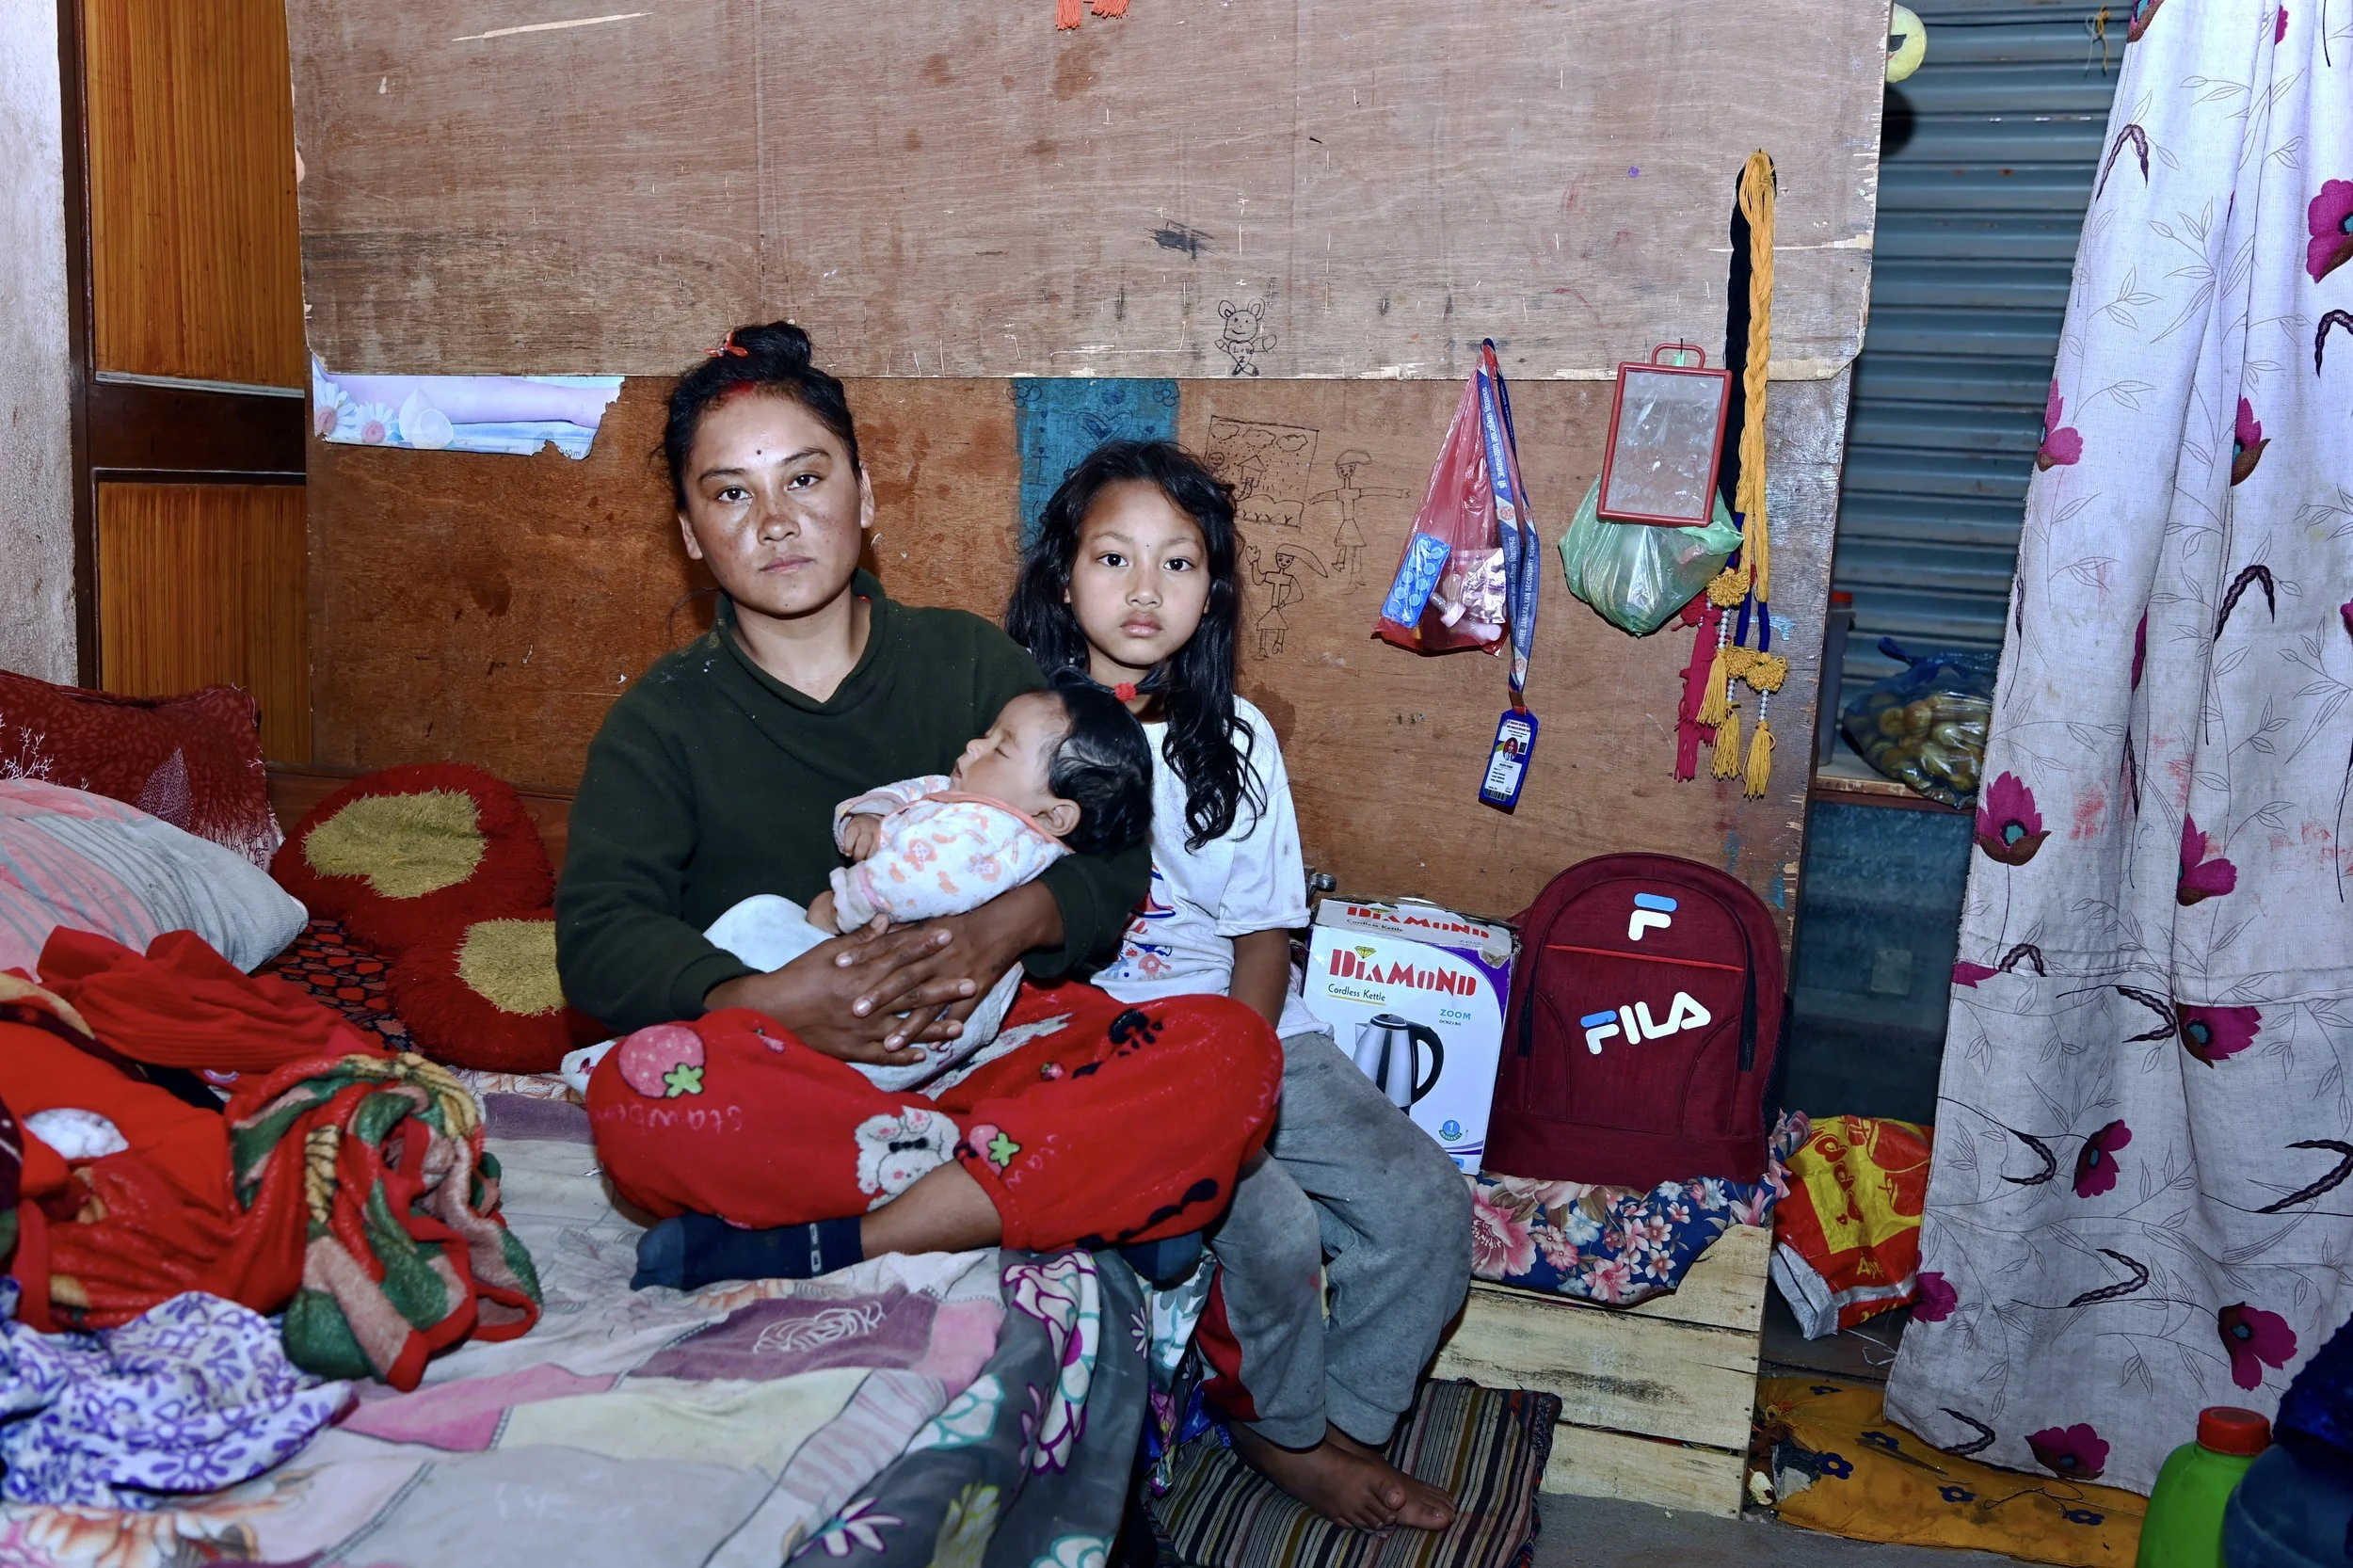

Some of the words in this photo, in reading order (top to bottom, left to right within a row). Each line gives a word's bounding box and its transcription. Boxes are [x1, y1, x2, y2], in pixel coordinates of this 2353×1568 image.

[1233, 345, 1254, 355] Love
[1482, 387, 1491, 412] विद्यालय
[1487, 412, 1497, 442] माध्यमिक
[1493, 443, 1505, 479] जनकल्याण
[1497, 480, 1507, 488] श्री
[1509, 536, 1517, 562] विद्यालय
[1525, 559, 1534, 592] SECONDARY
[1520, 593, 1531, 630] JANAKALYAN
[1518, 629, 1527, 648] SHREE
[1347, 919, 1379, 928] Cordless
[1381, 923, 1403, 932] Kettle
[1328, 984, 1360, 998] Cordless
[1363, 987, 1386, 1002] Kettle
[1439, 1008, 1472, 1020] ZOOM
[1580, 991, 1711, 1055] FILA
[1448, 1121, 1454, 1131] 1
